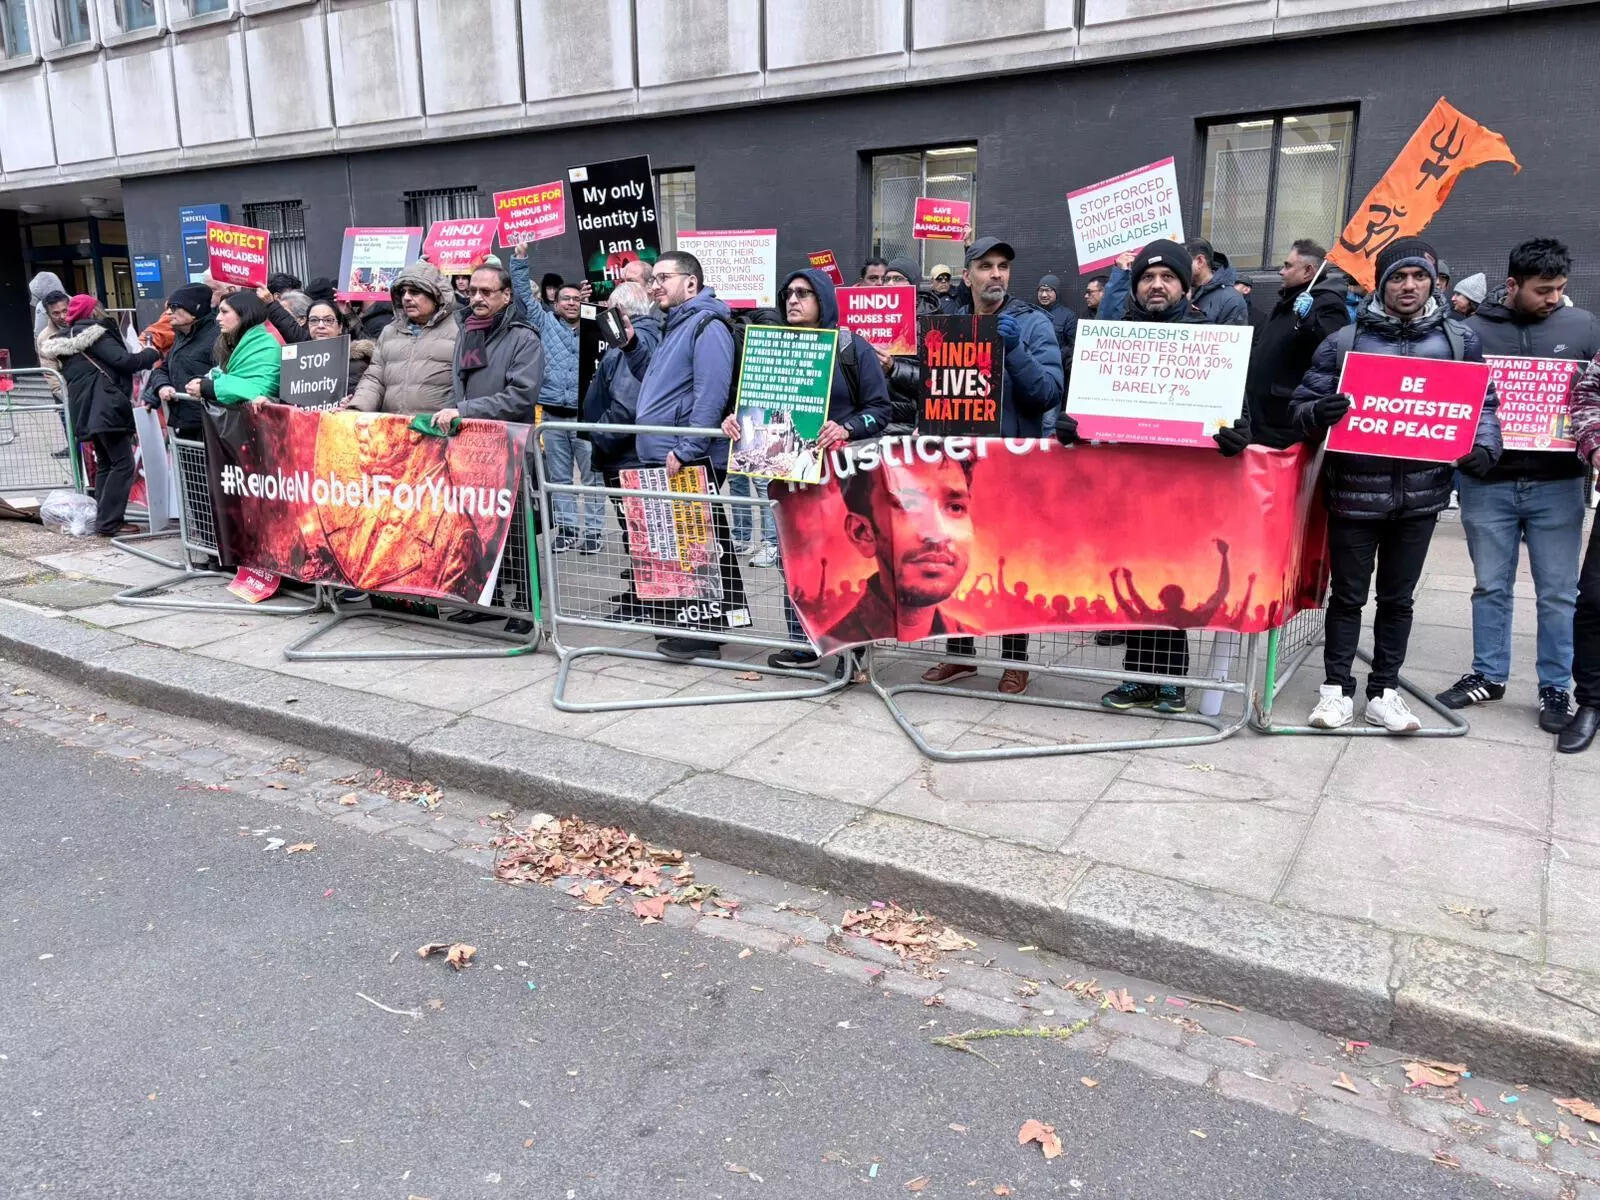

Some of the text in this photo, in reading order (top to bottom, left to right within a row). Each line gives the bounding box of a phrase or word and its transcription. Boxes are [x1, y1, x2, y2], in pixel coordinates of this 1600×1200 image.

[498, 188, 561, 210] JUSTICE FOR
[583, 180, 644, 205] My only
[1080, 195, 1110, 214] STOP
[1113, 177, 1164, 203] FORCED
[510, 203, 551, 218] HINDUS IN
[1075, 188, 1173, 229] CONVERSION OF
[504, 212, 559, 230] BANGLADESH
[577, 210, 638, 231] identity
[641, 206, 655, 222] is
[923, 215, 960, 224] HINDUS IN
[1081, 203, 1171, 242] HINDU GIRLS IN
[209, 228, 264, 250] PROTECT
[440, 224, 485, 237] HINDU
[1088, 219, 1168, 254] BANGLADESH
[433, 238, 482, 248] HOUSES SET
[599, 238, 645, 254] I am a
[679, 239, 770, 249] STOP DRIVING HINDUS
[210, 246, 264, 265] BANGLADESH
[440, 250, 472, 259] ON FIRE
[695, 248, 754, 257] OUT OF THEIR
[221, 262, 250, 277] HINDUS
[703, 266, 751, 274] ESTROYING
[727, 274, 765, 282] BURNING
[713, 283, 764, 291] BUSINESSES
[849, 294, 899, 310] HINDU
[847, 314, 902, 324] HOUSES SET
[856, 328, 893, 338] ON FIRE
[1081, 324, 1240, 343] BANGLADESH'S HINDU
[927, 342, 992, 367] HINDU
[1096, 338, 1220, 356] MINORITIES HAVE
[299, 352, 330, 370] STOP
[1080, 350, 1233, 370] DECLINED FROM 30%
[1537, 361, 1562, 371] BBC
[1564, 362, 1574, 372] &
[1099, 364, 1211, 381] IN 1947 TO NOW
[1507, 372, 1549, 381] MEDIA
[1551, 373, 1568, 382] TO
[290, 376, 338, 395] Minority
[930, 369, 992, 397] LIVES
[1112, 380, 1191, 397] BARELY 7%
[1400, 376, 1426, 393] BE
[1538, 382, 1567, 392] AND
[1505, 391, 1545, 401] CYCLE
[1546, 393, 1564, 402] OF
[925, 398, 996, 422] MATTER
[1362, 396, 1473, 420] PROTESTER
[1535, 414, 1549, 423] IN
[1347, 416, 1458, 441] FOR PEACE
[220, 464, 512, 518] #RevokeNobelForYunus
[677, 602, 722, 623] STOP
